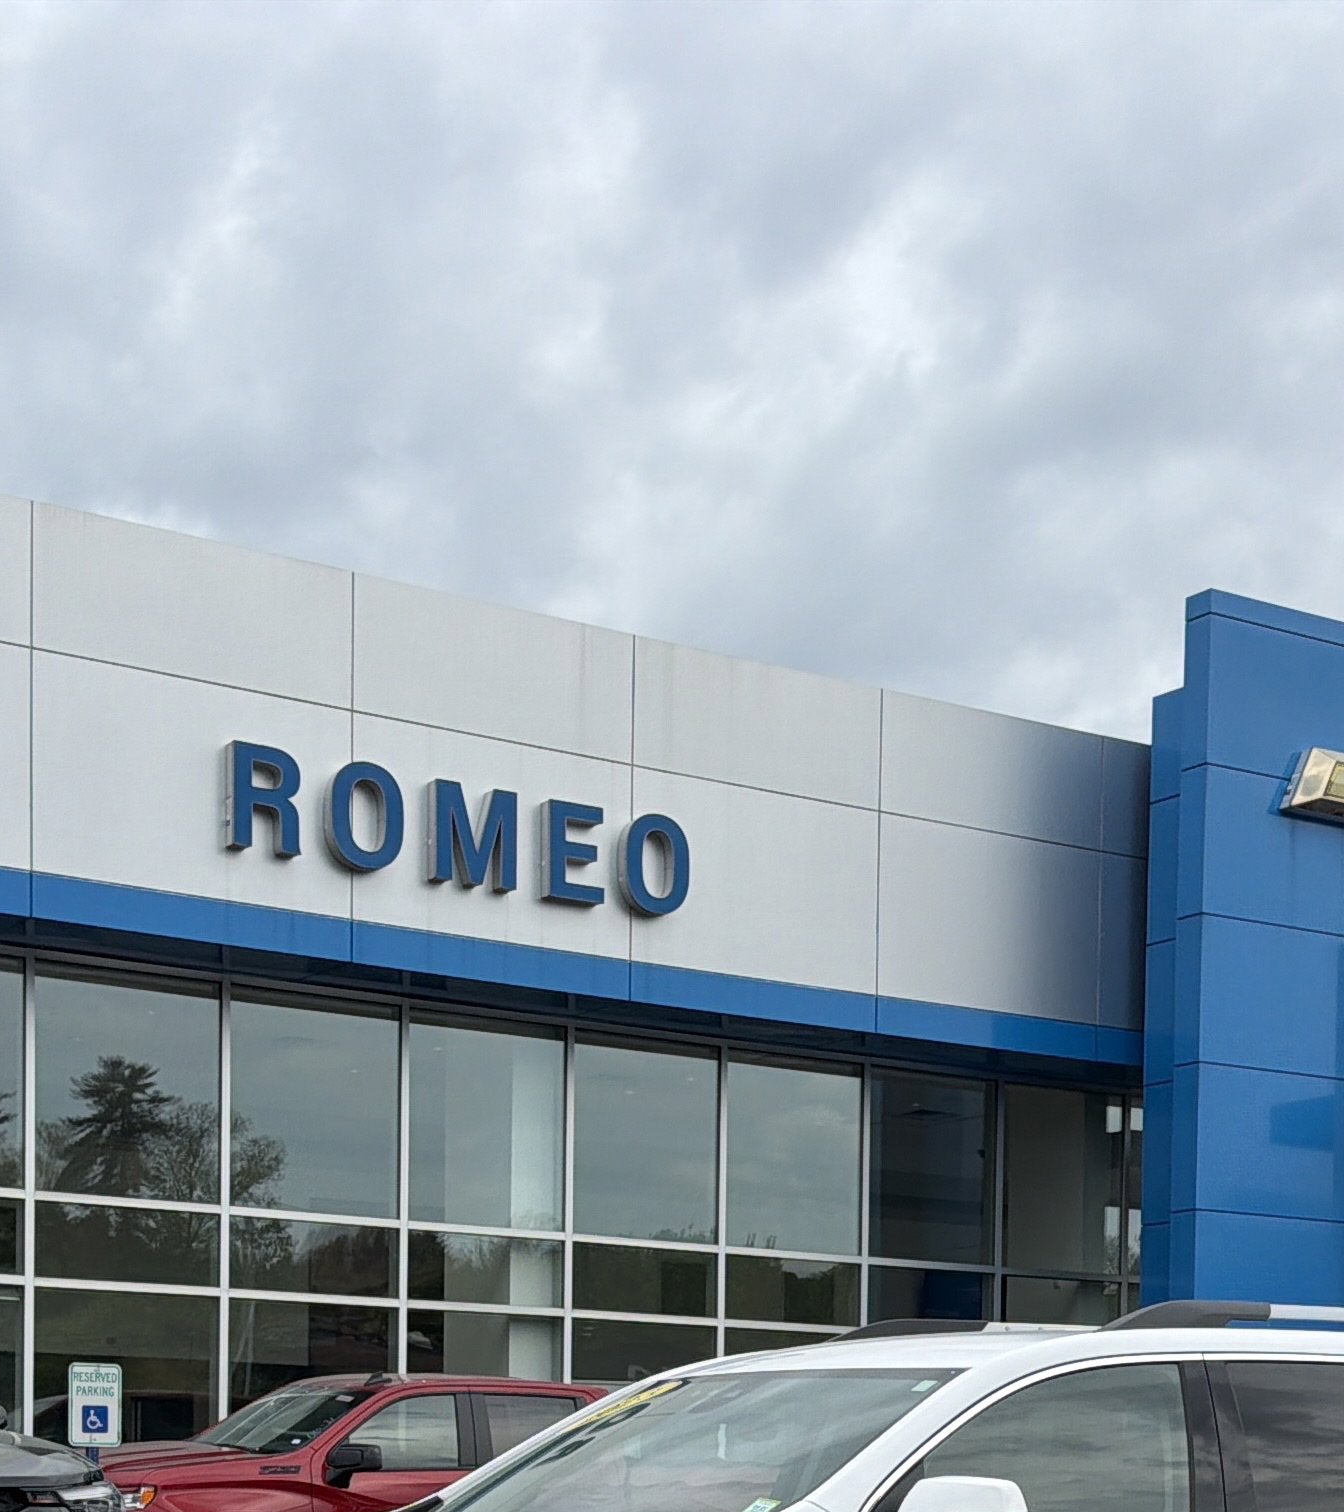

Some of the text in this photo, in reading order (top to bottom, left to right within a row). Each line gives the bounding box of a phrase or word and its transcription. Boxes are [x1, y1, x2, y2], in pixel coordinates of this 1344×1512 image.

[225, 739, 690, 917] ROMEO
[72, 1371, 117, 1383] RESERVED
[76, 1386, 115, 1398] PARKING
